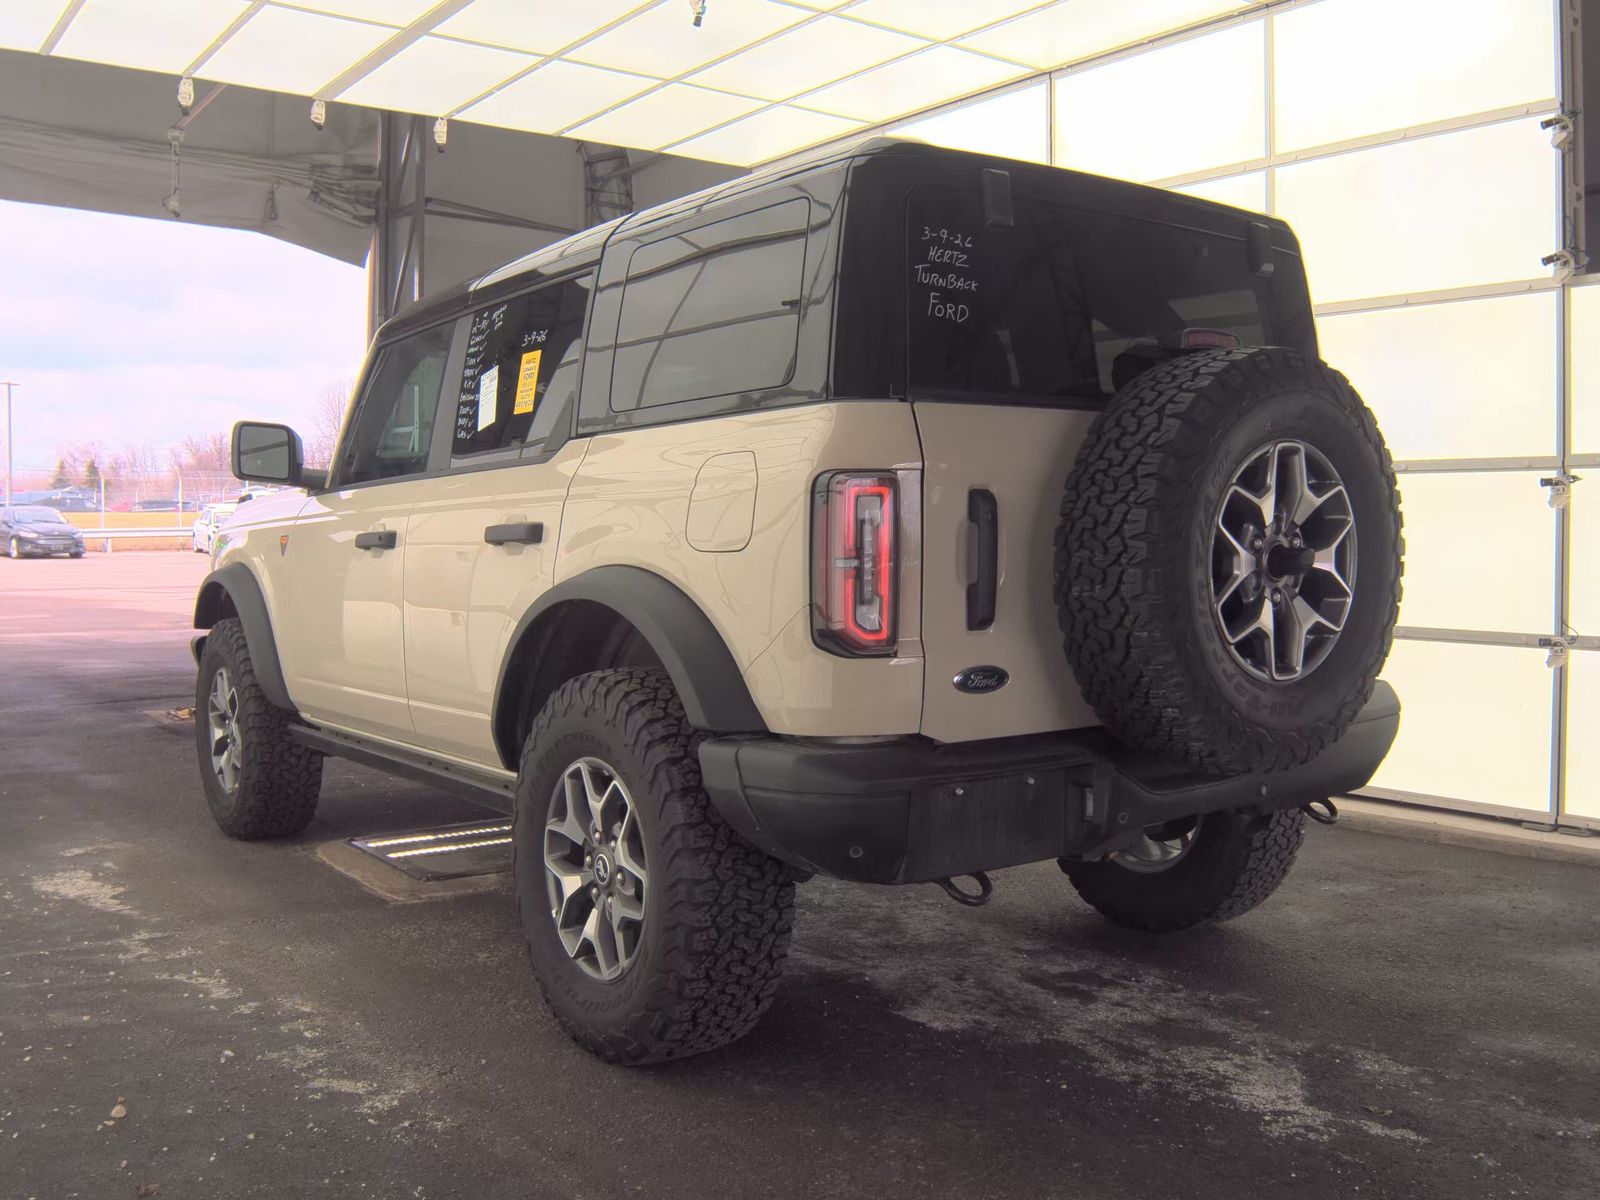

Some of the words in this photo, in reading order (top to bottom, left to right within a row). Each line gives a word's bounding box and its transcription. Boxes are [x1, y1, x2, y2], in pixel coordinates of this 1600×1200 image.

[921, 226, 973, 248] 3-9-26
[928, 246, 969, 267] HERTZ
[521, 329, 549, 347] 3-9-26
[967, 671, 999, 689] Ford
